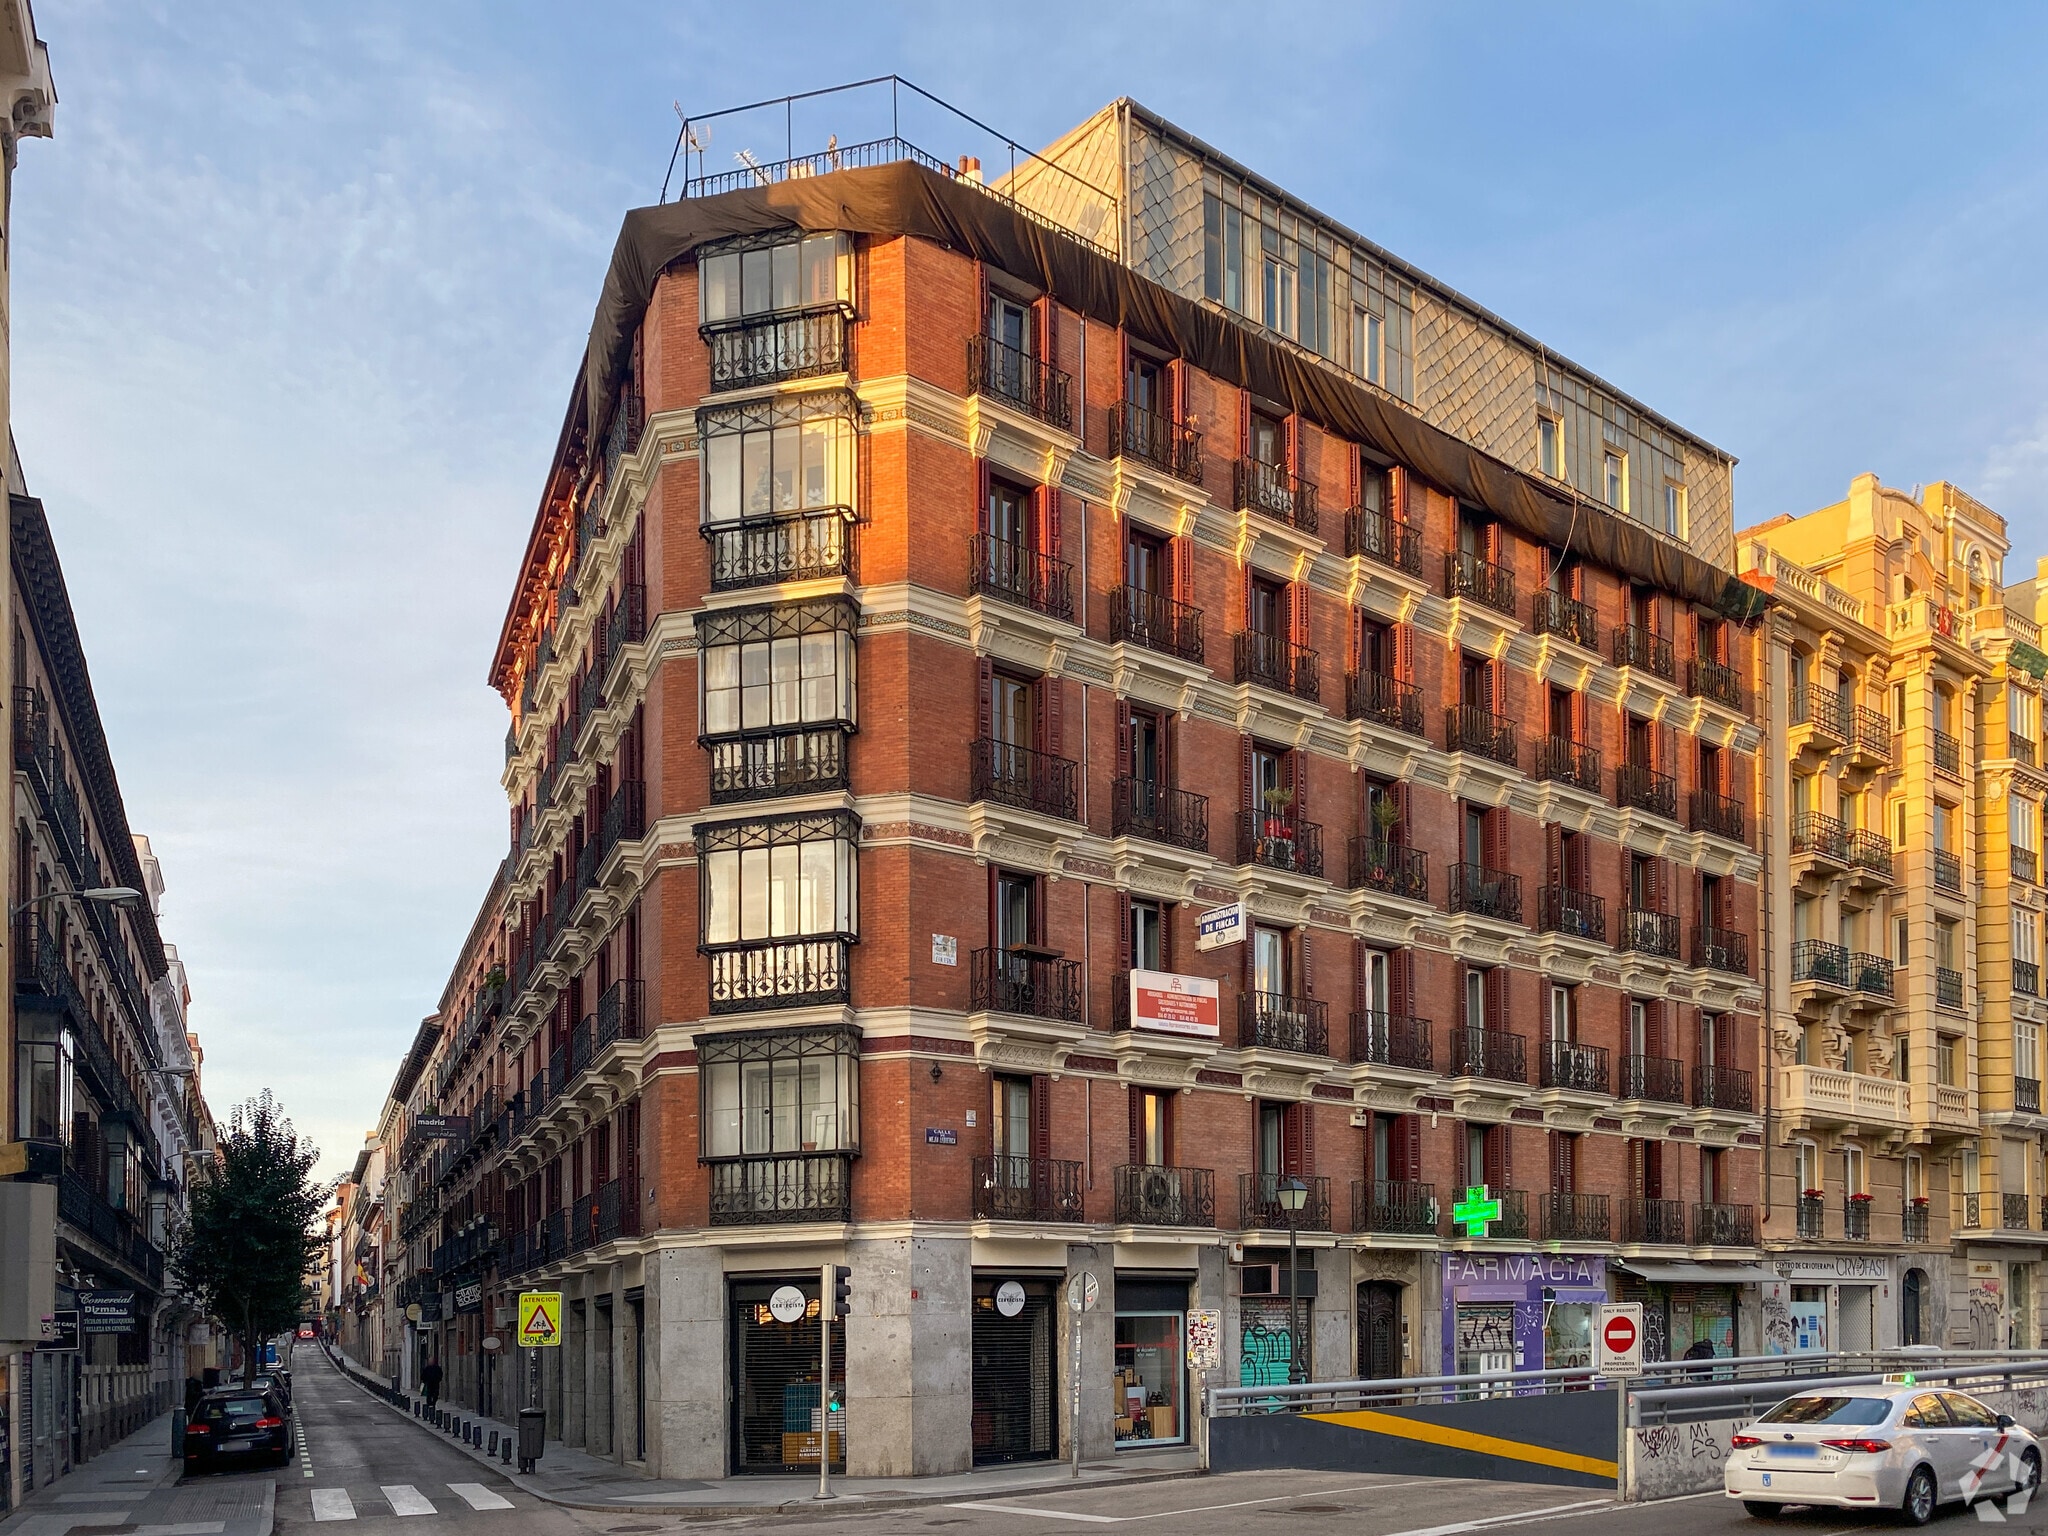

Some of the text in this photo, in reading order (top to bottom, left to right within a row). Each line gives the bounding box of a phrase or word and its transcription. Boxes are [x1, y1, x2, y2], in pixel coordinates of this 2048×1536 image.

[1205, 917, 1236, 933] DE FINCAS
[1446, 1256, 1591, 1281] FARMACIA
[1775, 1261, 1795, 1269] CENTRO
[1795, 1261, 1802, 1269] DE
[1802, 1261, 1835, 1270] CRIOTERAPIA
[78, 1292, 135, 1305] Comercial
